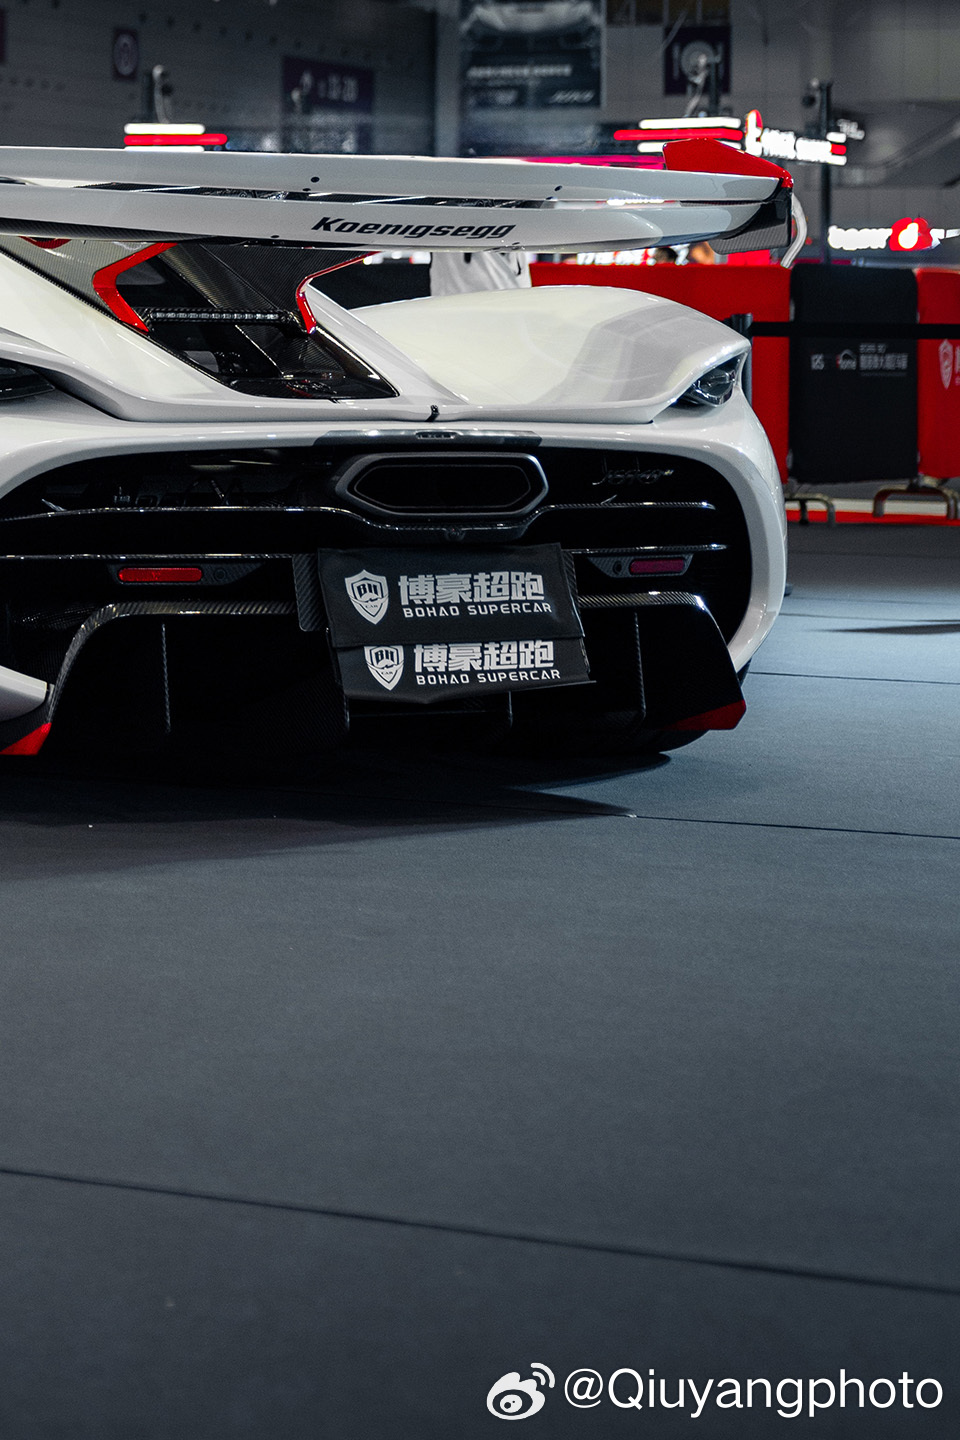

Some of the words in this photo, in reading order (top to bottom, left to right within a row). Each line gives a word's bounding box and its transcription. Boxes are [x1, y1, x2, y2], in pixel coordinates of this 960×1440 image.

[311, 217, 516, 239] Koenigsegg
[398, 571, 545, 606] 博豪超跑
[403, 605, 460, 618] BOHAO
[469, 602, 552, 616] SUPERCAR
[414, 640, 554, 673] 博豪超跑
[416, 674, 470, 686] BOHAO
[477, 669, 561, 683] SUPERCAR
